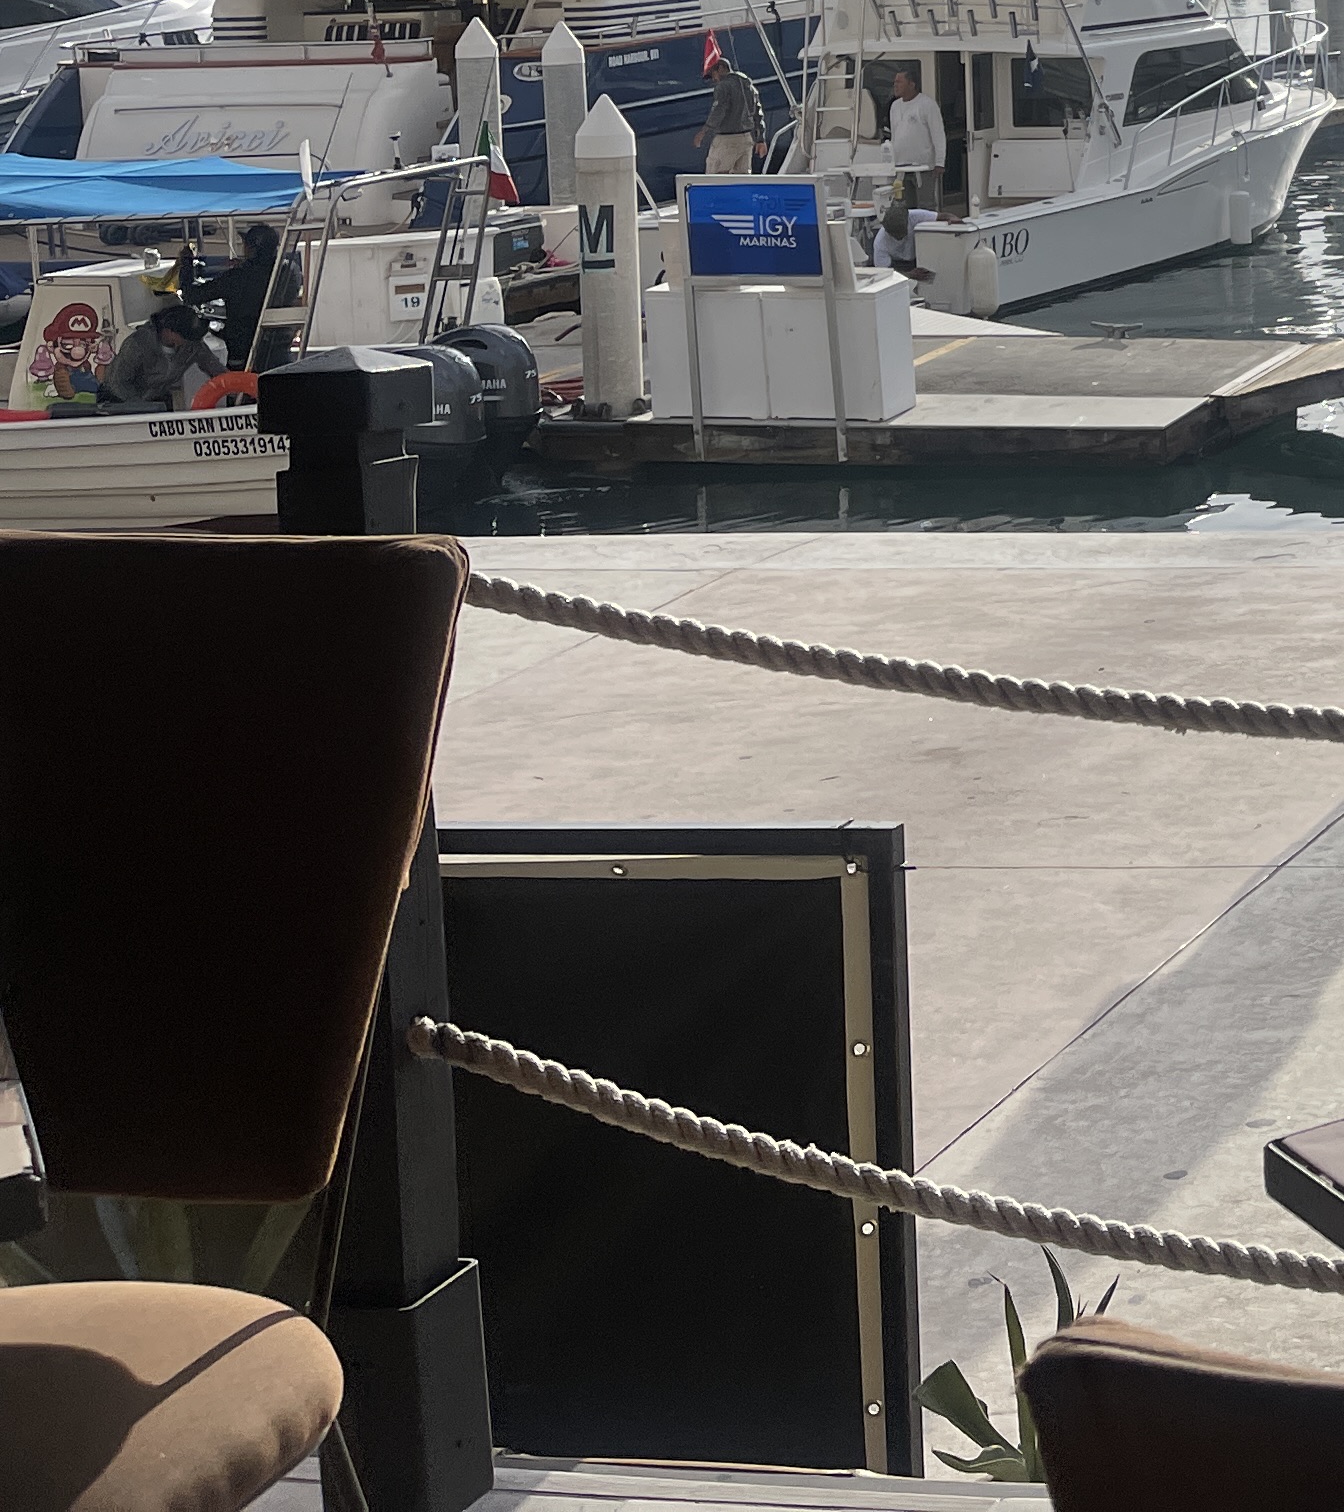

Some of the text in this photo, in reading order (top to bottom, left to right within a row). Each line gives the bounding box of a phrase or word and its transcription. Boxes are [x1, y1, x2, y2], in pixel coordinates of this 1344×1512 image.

[578, 204, 615, 254] M
[759, 215, 798, 236] IGY
[740, 236, 797, 248] MARINAS
[401, 297, 420, 308] 19
[71, 317, 89, 328] M
[525, 369, 537, 378] 75
[470, 392, 483, 404] 75
[149, 414, 258, 437] CABO SAN LUCAS
